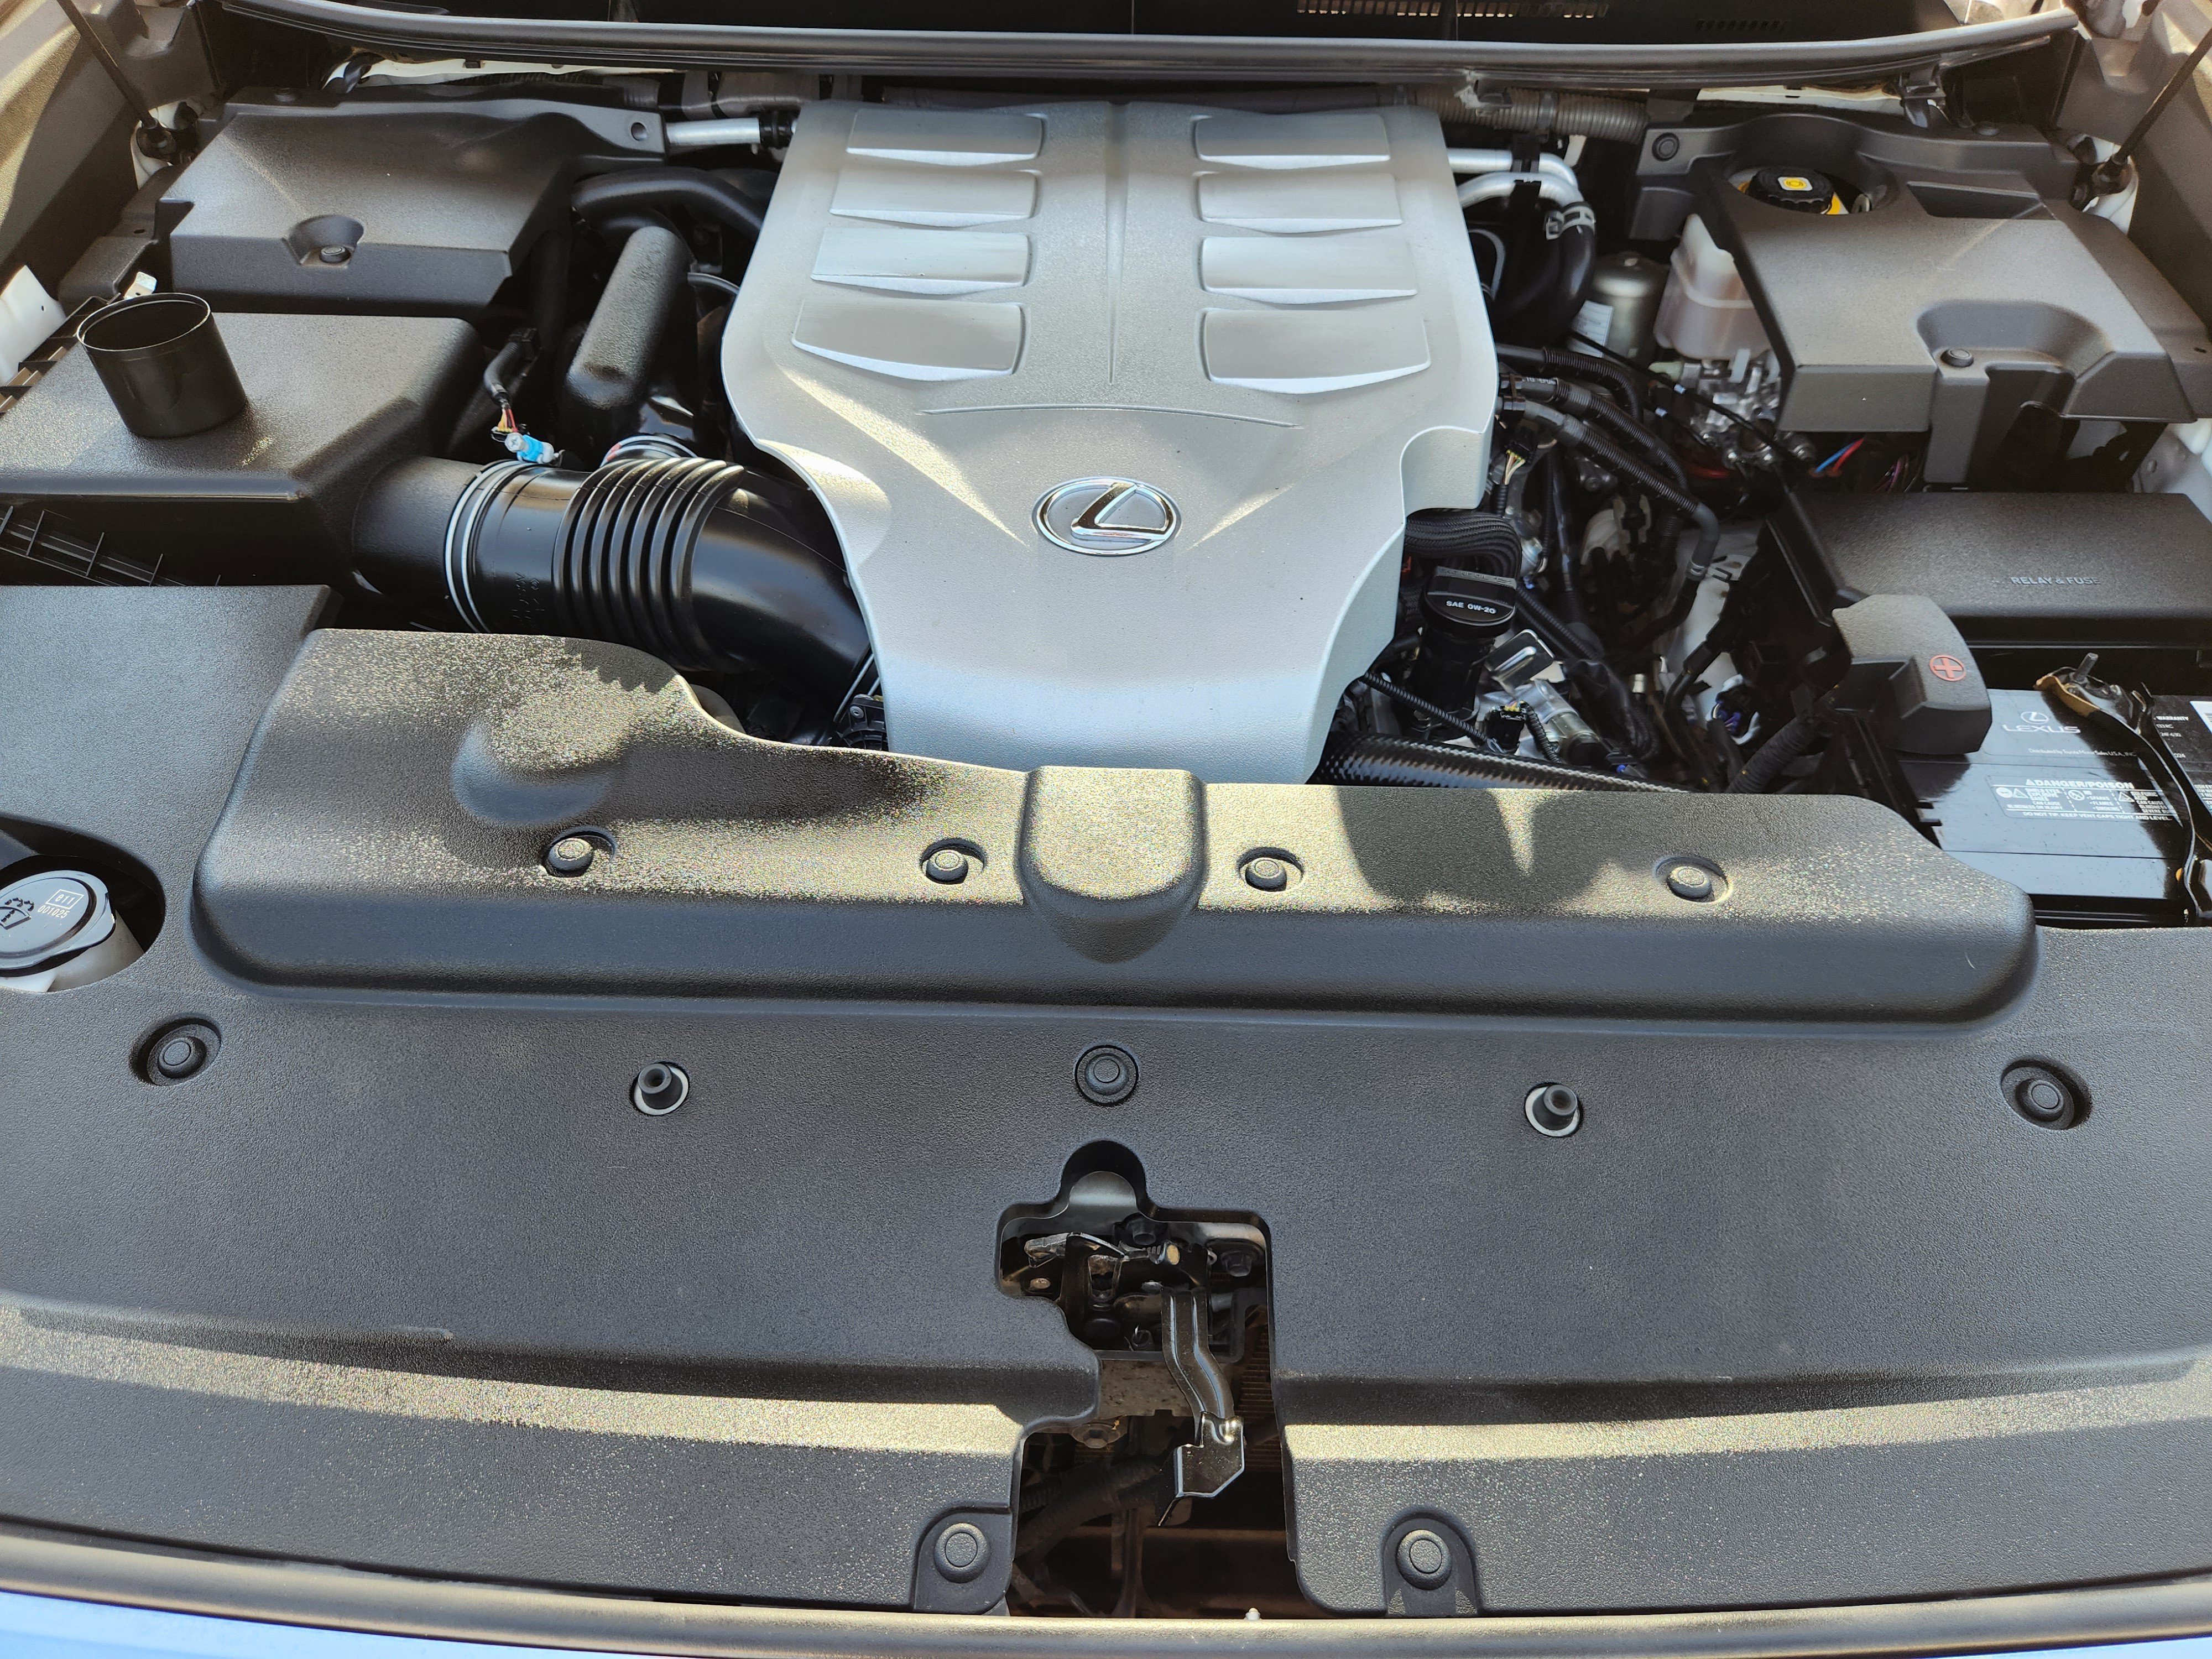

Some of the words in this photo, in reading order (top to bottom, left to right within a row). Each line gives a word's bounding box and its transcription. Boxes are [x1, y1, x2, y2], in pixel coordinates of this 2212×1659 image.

[1467, 604, 1497, 614] 0W-20
[2002, 724, 2081, 734] LEXUS
[2034, 780, 2135, 789] DANGER/POISON
[55, 894, 75, 905] e11
[38, 905, 70, 919] 001025
